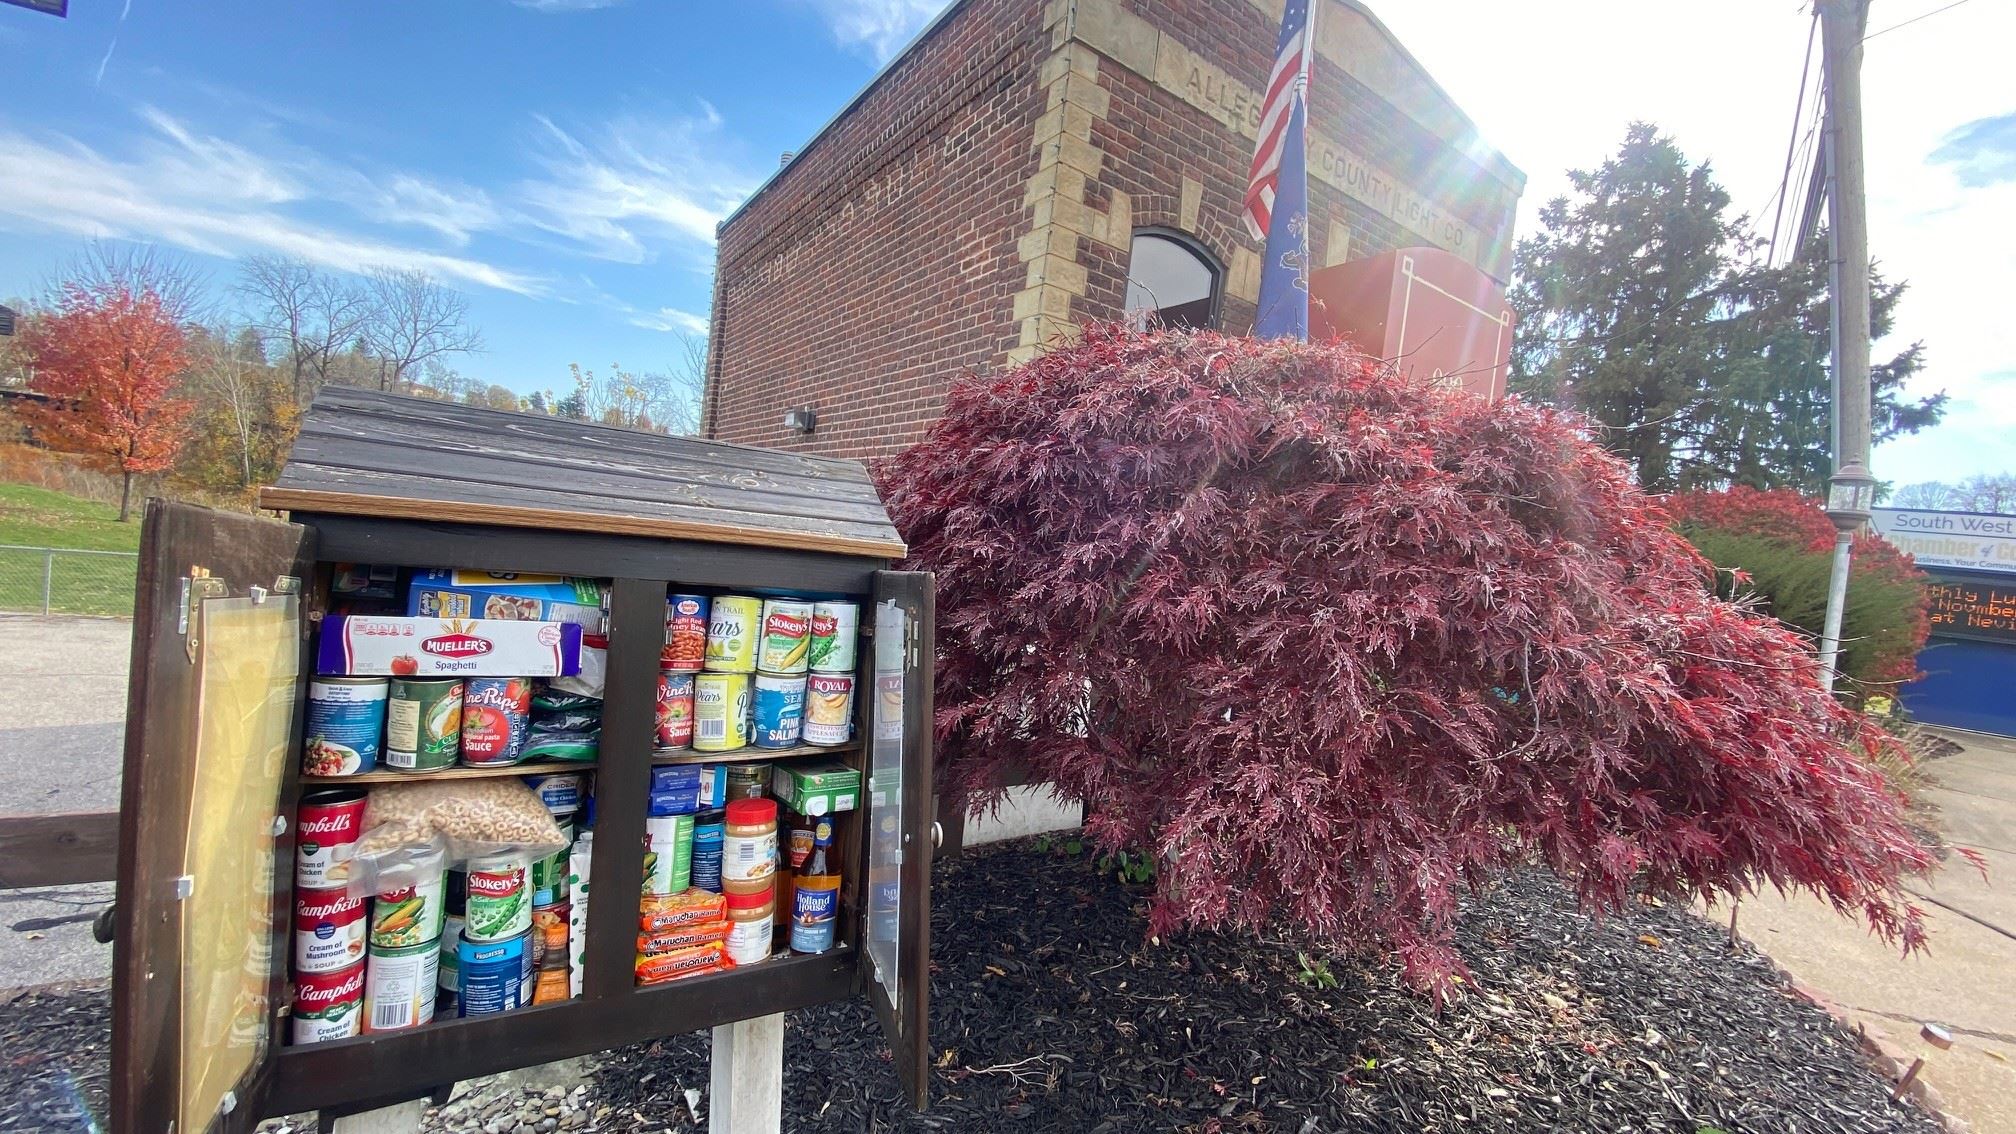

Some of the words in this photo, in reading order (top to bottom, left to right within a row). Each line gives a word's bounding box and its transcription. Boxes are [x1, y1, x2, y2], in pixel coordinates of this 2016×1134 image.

[1322, 151, 1393, 200] COUNTY
[1395, 191, 1440, 233] LIGHT
[1895, 514, 1953, 530] South
[1961, 518, 2013, 534] West
[1955, 559, 1976, 567] Your
[690, 617, 702, 625] Red
[769, 615, 807, 632] Stokely's
[1930, 612, 1955, 624] at
[427, 640, 488, 652] MUELLER'S
[435, 660, 477, 672] Spaghetti
[814, 680, 847, 692] ROYAL
[657, 683, 685, 702] Vine
[484, 687, 519, 711] Ripe
[669, 727, 691, 738] Sauce
[465, 740, 492, 752] Sauce
[470, 871, 520, 891] Stokely's
[797, 893, 830, 907] Holland
[798, 901, 827, 913] House
[660, 911, 699, 924] Maruchan
[309, 943, 333, 952] Cream
[334, 941, 343, 949] of
[653, 935, 695, 947] Maruchan
[306, 948, 346, 960] Mushroom
[317, 1023, 342, 1036] Cream
[343, 1020, 351, 1029] of
[319, 1029, 348, 1043] Chicken
